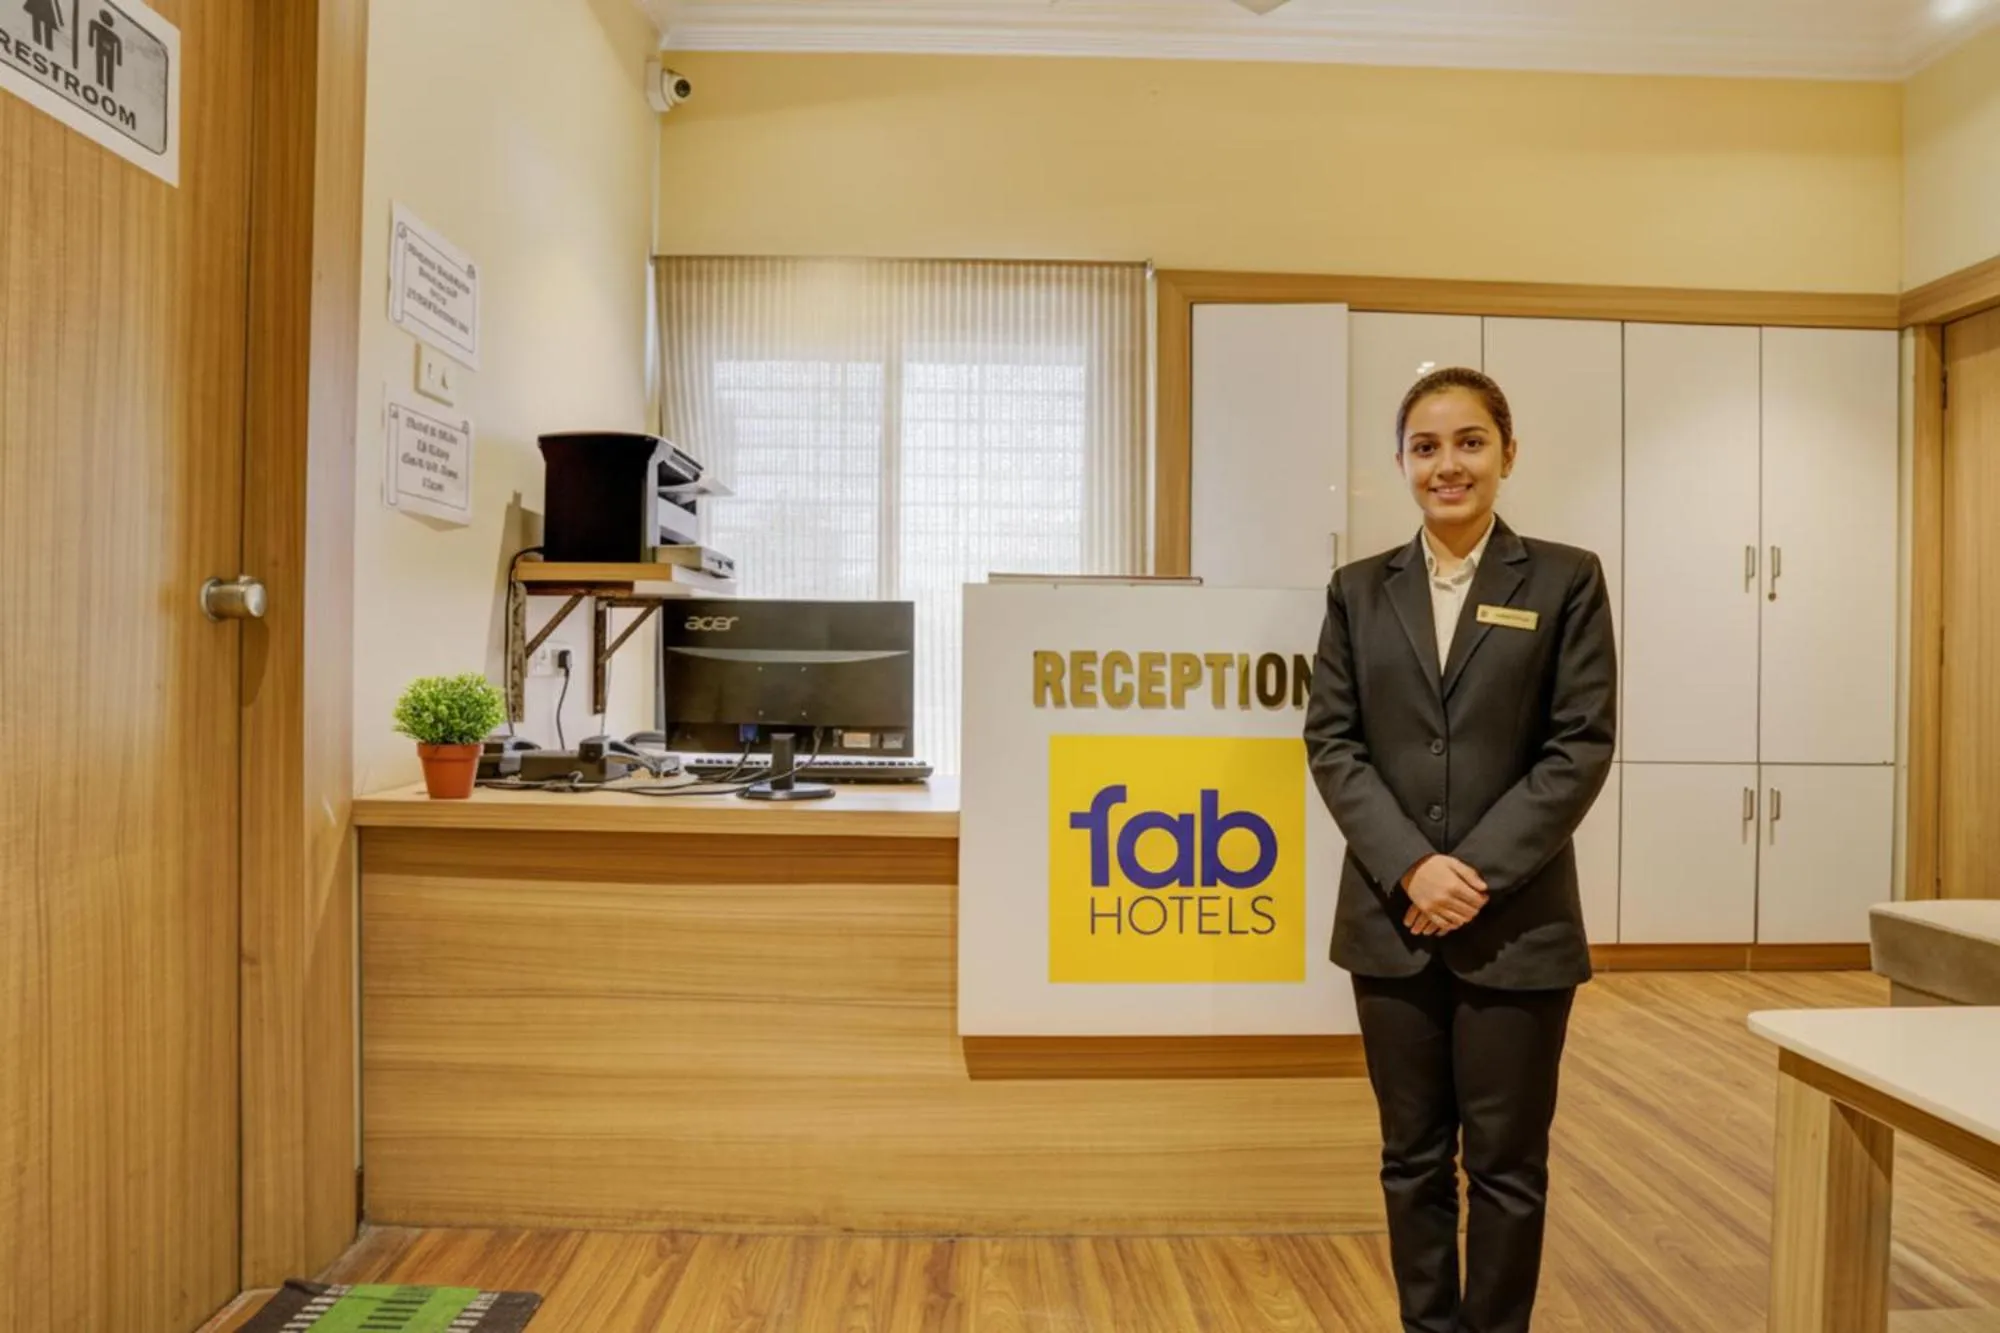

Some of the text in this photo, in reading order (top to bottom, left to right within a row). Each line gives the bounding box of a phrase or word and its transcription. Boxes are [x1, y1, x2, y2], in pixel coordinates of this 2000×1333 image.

[0, 27, 137, 131] RESTROOM
[684, 616, 739, 631] acer
[1033, 650, 1317, 708] RECEPTION
[1069, 784, 1278, 889] fab
[1090, 895, 1276, 935] HOTELS
